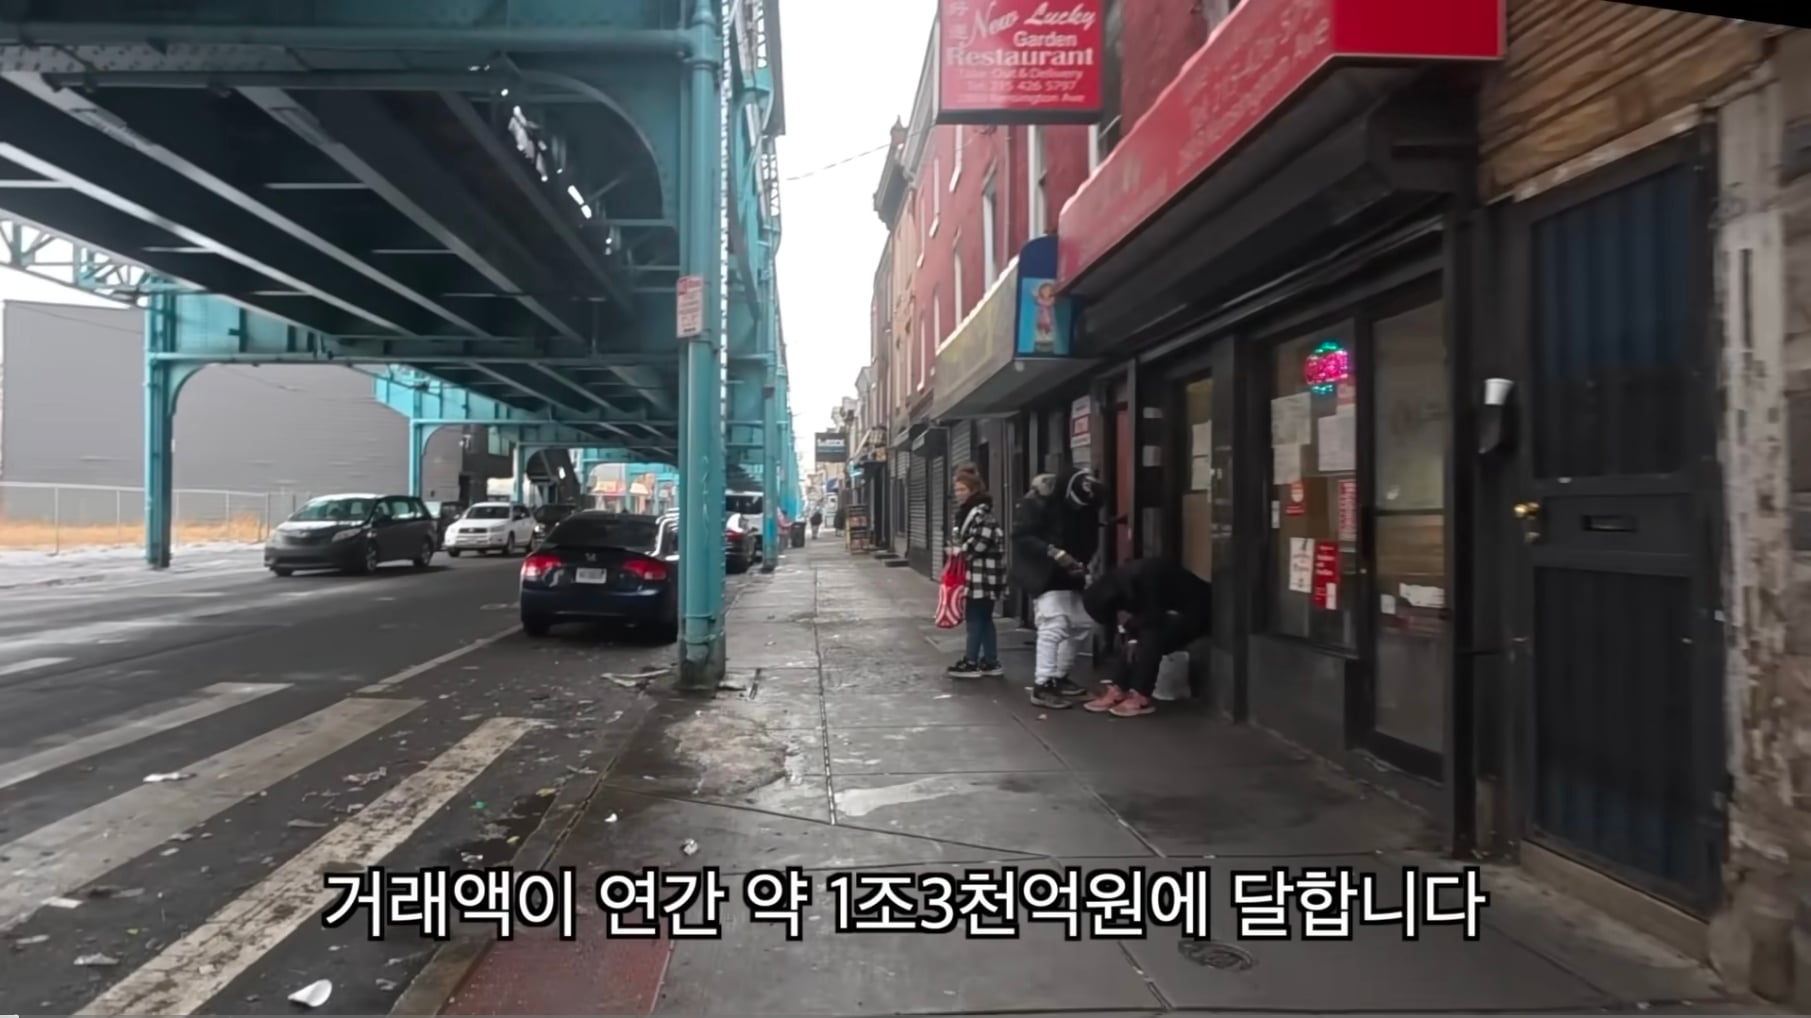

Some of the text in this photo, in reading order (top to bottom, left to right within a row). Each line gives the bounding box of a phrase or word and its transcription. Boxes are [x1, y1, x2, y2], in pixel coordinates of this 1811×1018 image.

[960, 0, 1020, 47] New
[1024, 1, 1097, 31] Lucky
[1012, 30, 1078, 48] Garden
[946, 47, 1095, 67] Restaurant
